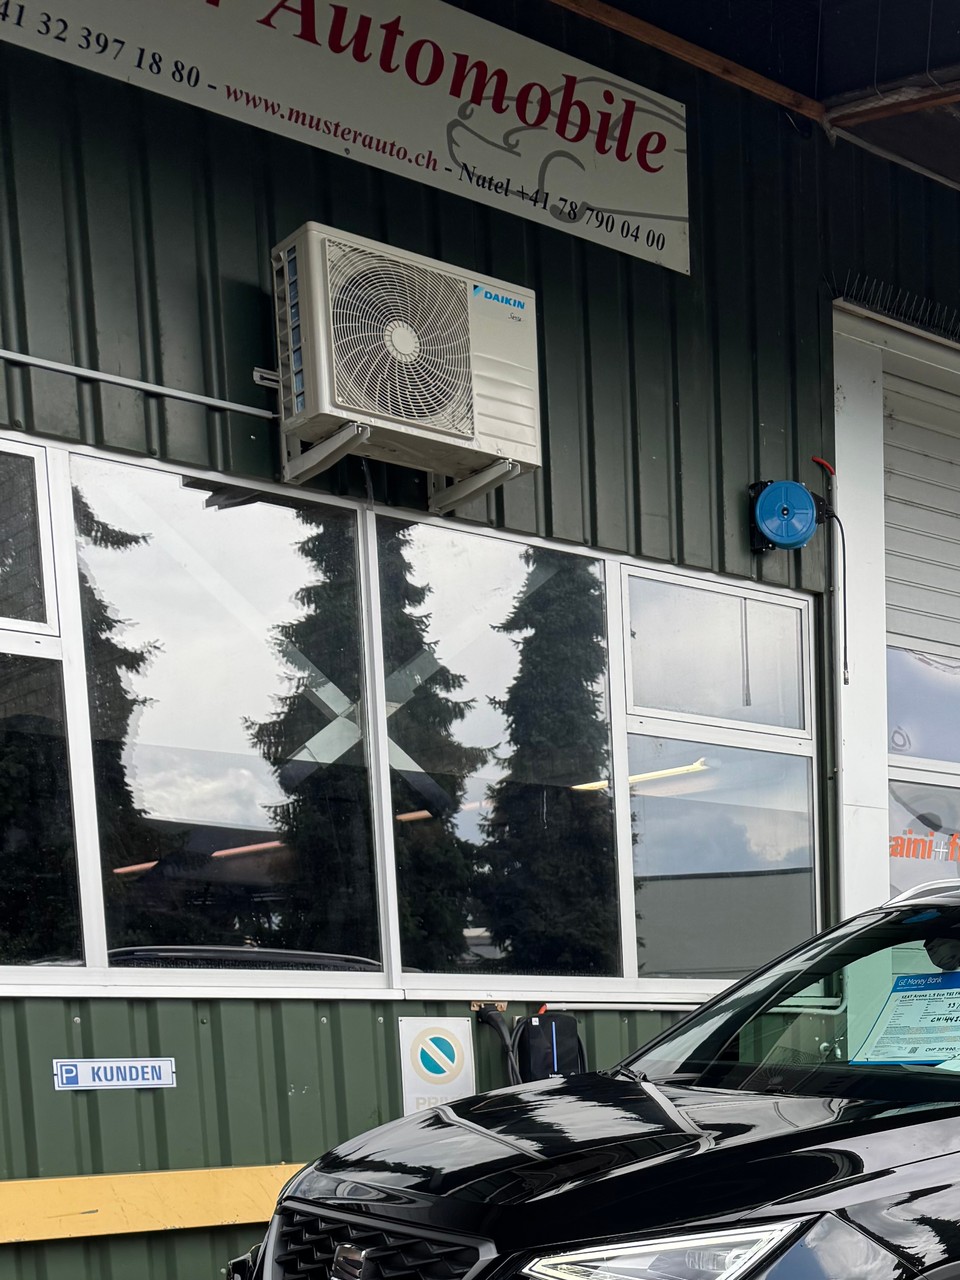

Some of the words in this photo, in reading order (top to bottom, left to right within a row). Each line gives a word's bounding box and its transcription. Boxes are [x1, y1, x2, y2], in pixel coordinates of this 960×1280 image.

[37, 12, 69, 42] 32
[78, 26, 126, 60] 397
[134, 47, 163, 75] 18
[171, 60, 201, 88] 80
[224, 84, 438, 172] www.musterauto.ch
[458, 162, 511, 197] Natel
[516, 185, 551, 211] +41
[558, 197, 578, 221] 78
[585, 206, 615, 233] 790
[620, 220, 640, 243] 04
[646, 229, 666, 251] 00
[257, 0, 668, 174] Automobile
[484, 290, 525, 310] DAIKIN
[91, 1065, 162, 1082] KUNDEN
